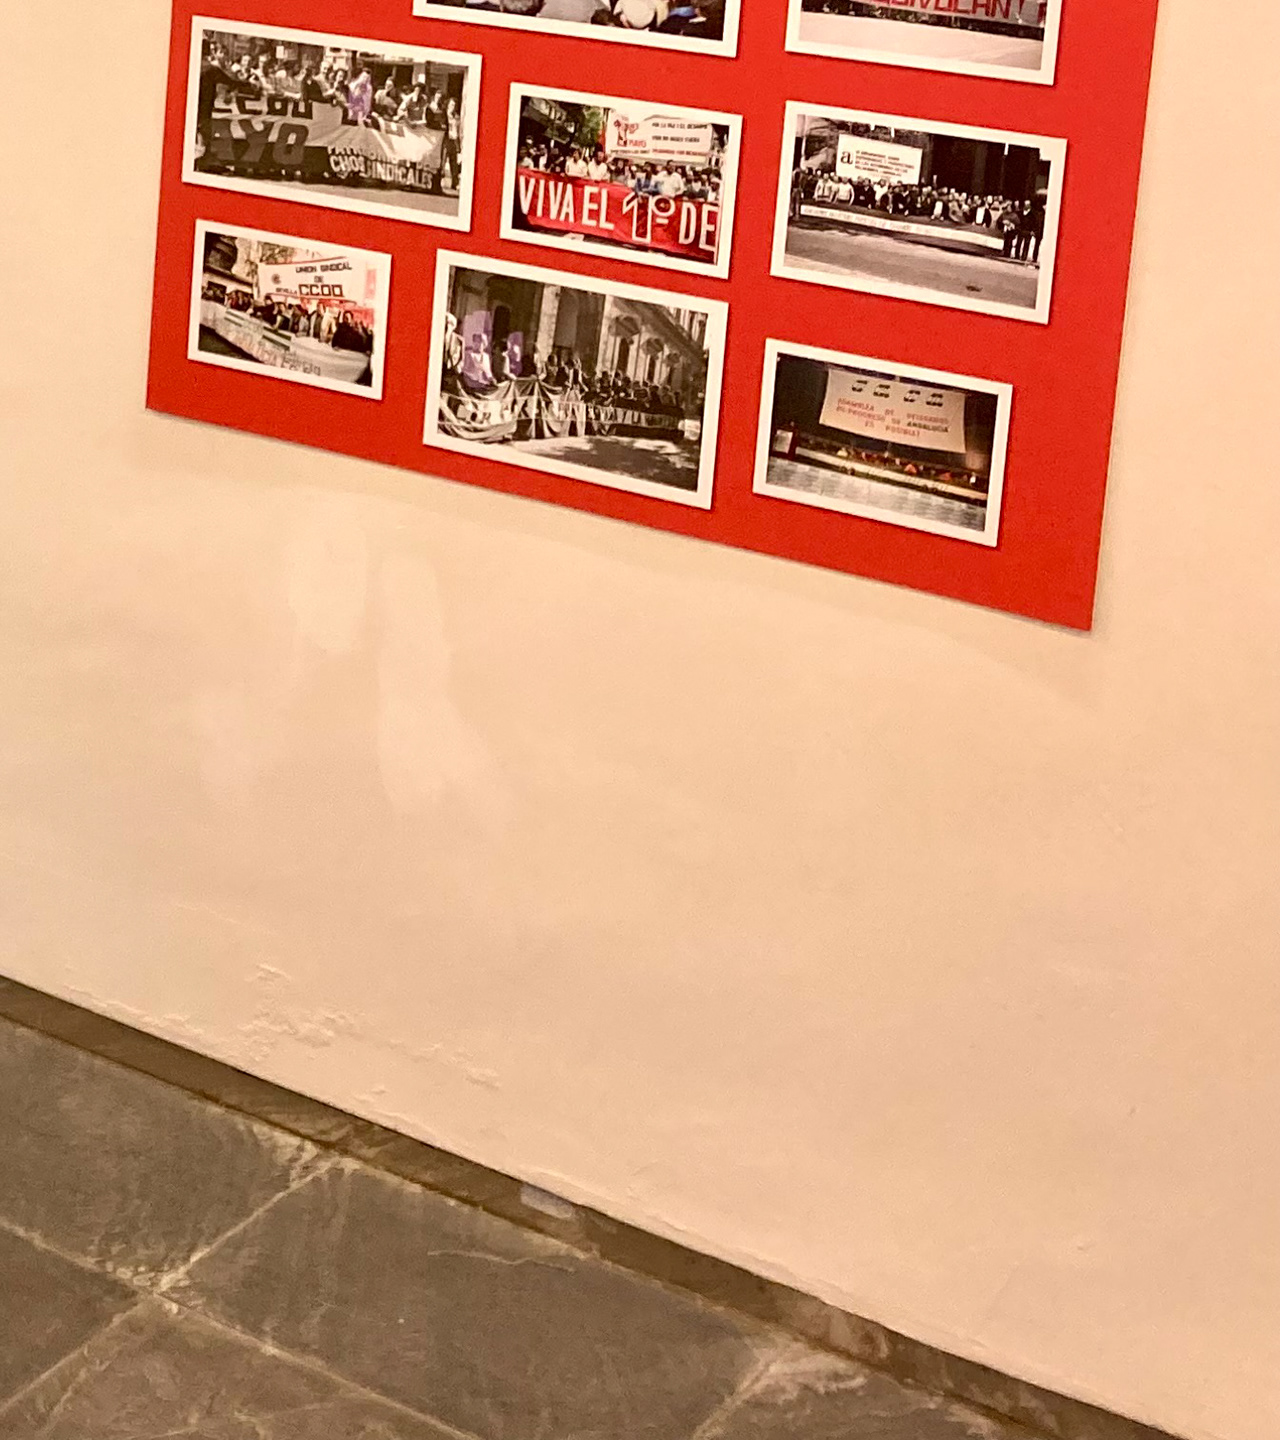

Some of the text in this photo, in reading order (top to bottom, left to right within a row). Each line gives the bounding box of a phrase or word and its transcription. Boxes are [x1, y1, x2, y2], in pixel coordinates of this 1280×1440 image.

[519, 174, 576, 224] VIVA
[581, 185, 615, 230] EL
[678, 201, 721, 252] DE
